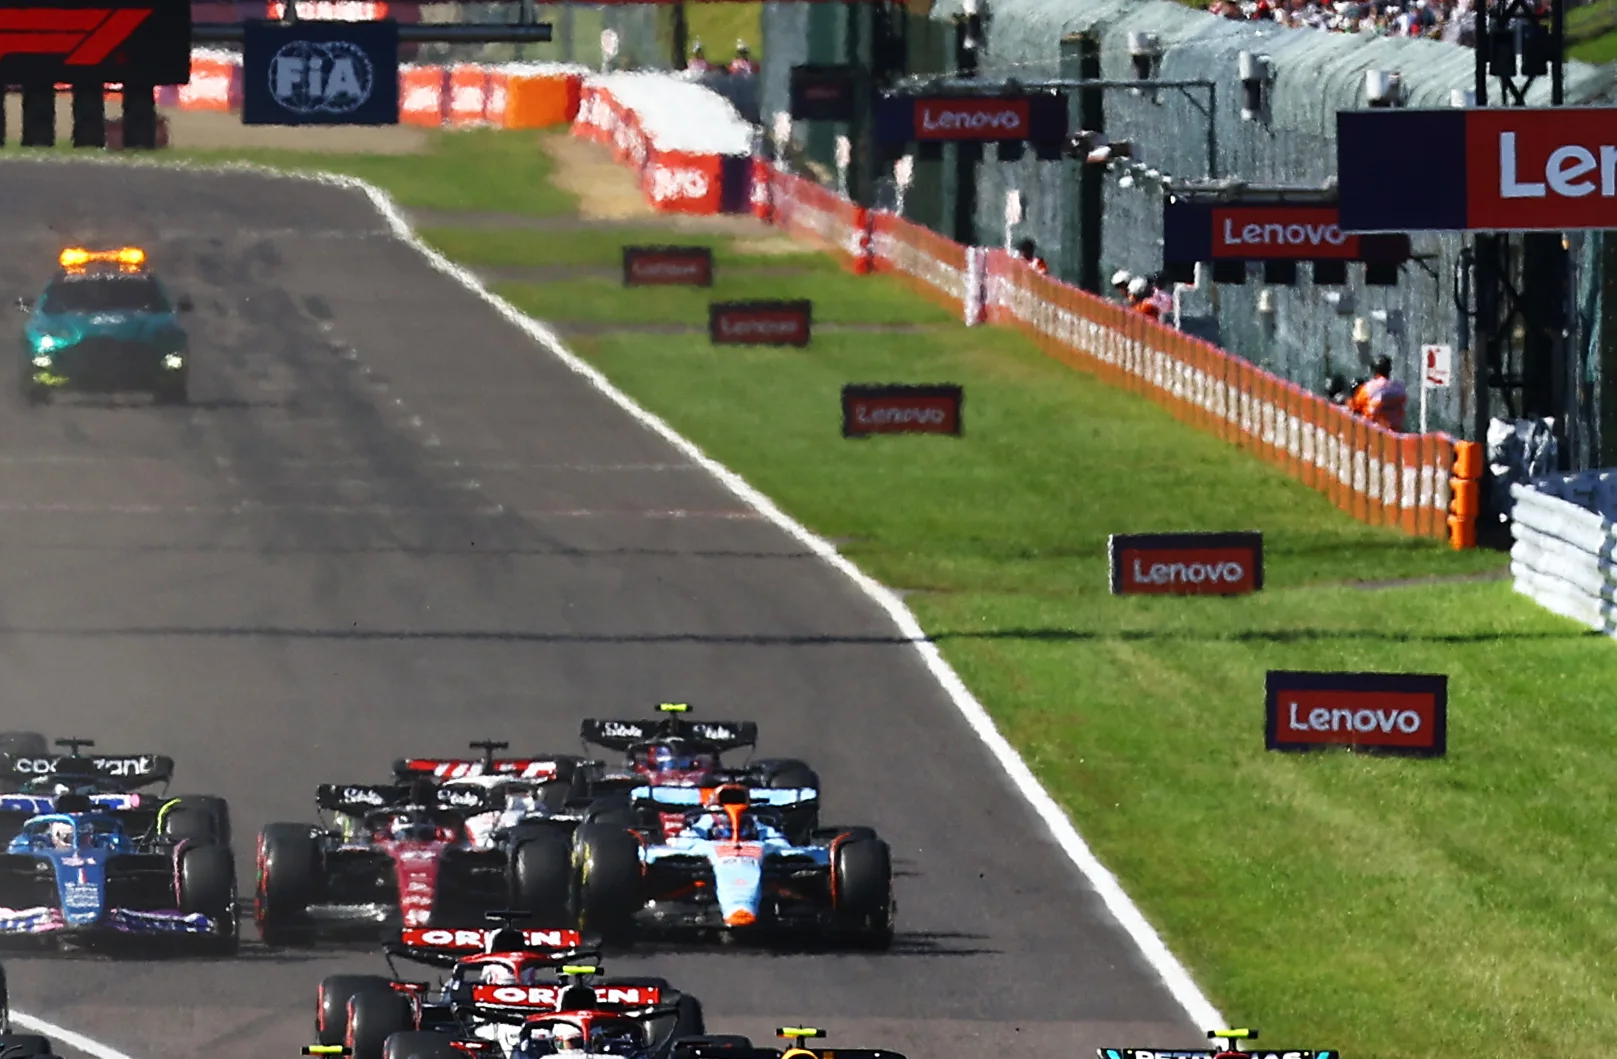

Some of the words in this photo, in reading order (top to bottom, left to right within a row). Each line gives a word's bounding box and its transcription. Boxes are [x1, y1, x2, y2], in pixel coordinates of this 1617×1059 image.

[923, 107, 1021, 131] Lenovo
[1224, 218, 1346, 245] Lenovo
[857, 403, 945, 424] Lenovo
[1133, 556, 1244, 584] Lenovo
[1288, 702, 1421, 735] Lenovo
